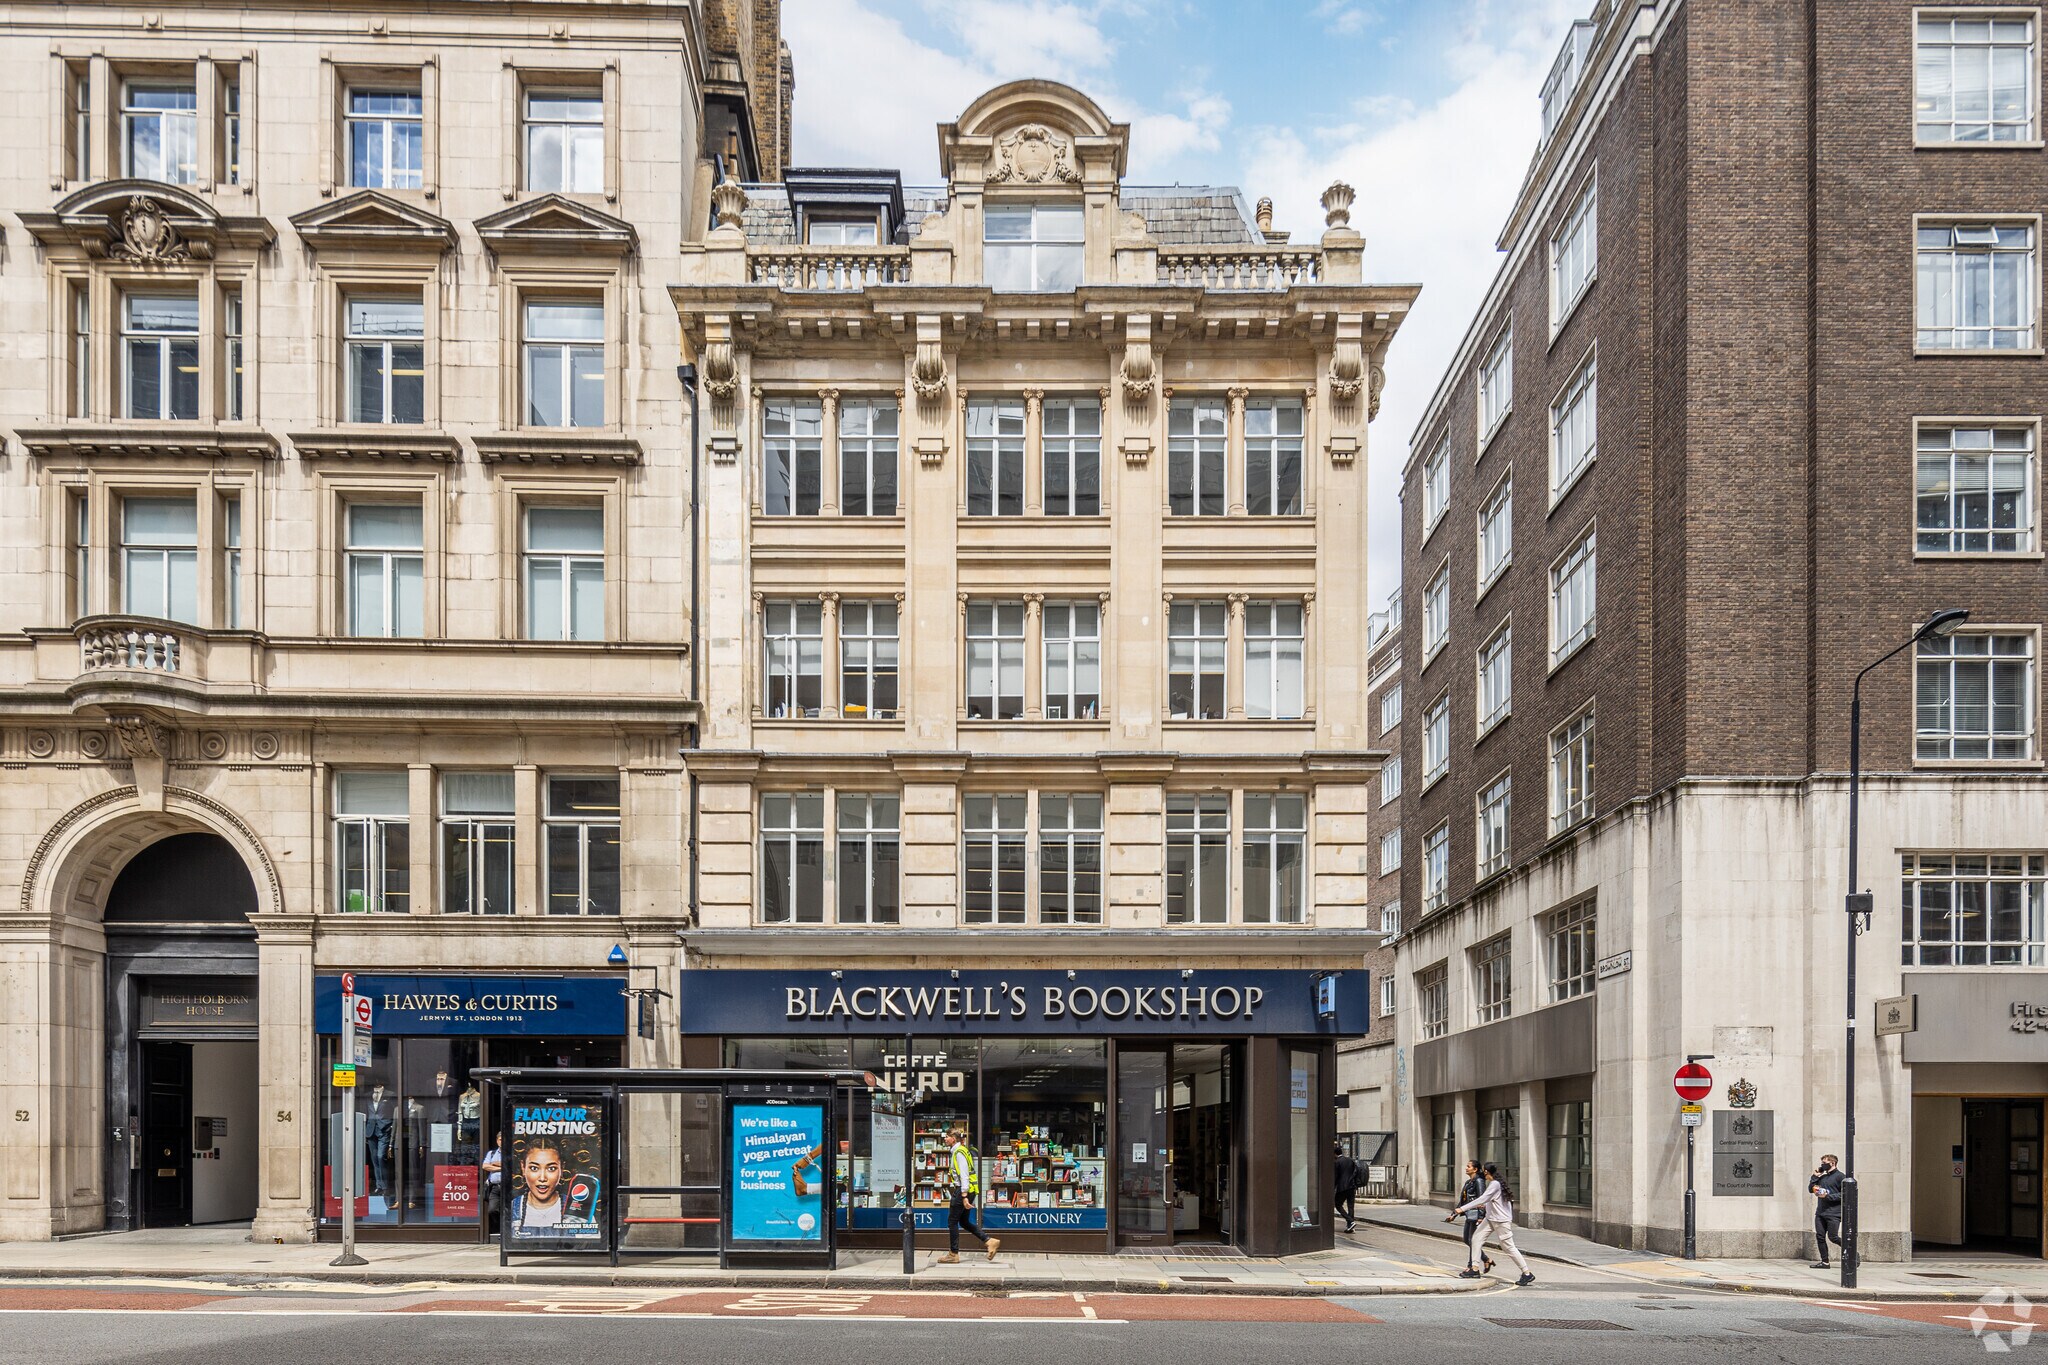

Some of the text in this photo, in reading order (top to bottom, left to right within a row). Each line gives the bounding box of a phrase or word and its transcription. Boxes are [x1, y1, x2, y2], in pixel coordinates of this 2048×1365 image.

[347, 976, 353, 991] S
[161, 995, 249, 1004] HIGH HOLBORN
[383, 994, 558, 1011] HAWES & CURTIS
[785, 982, 1263, 1016] BLACKWELL'S BOOKSHOP
[186, 1006, 224, 1015] HOUSE
[867, 1072, 964, 1092] NERO
[15, 1110, 29, 1121] 52
[277, 1110, 292, 1122] 54
[514, 1107, 587, 1121] FLAVOUR
[514, 1121, 596, 1135] BURSTING
[740, 1117, 769, 1127] We're
[770, 1117, 789, 1127] like
[745, 1132, 806, 1146] Himalayan
[743, 1144, 812, 1163] yoga retreat
[740, 1168, 781, 1180] for your
[445, 1181, 452, 1191] 4
[740, 1181, 786, 1190] business
[442, 1192, 470, 1201] £100
[1007, 1213, 1082, 1224] STATIONERY
